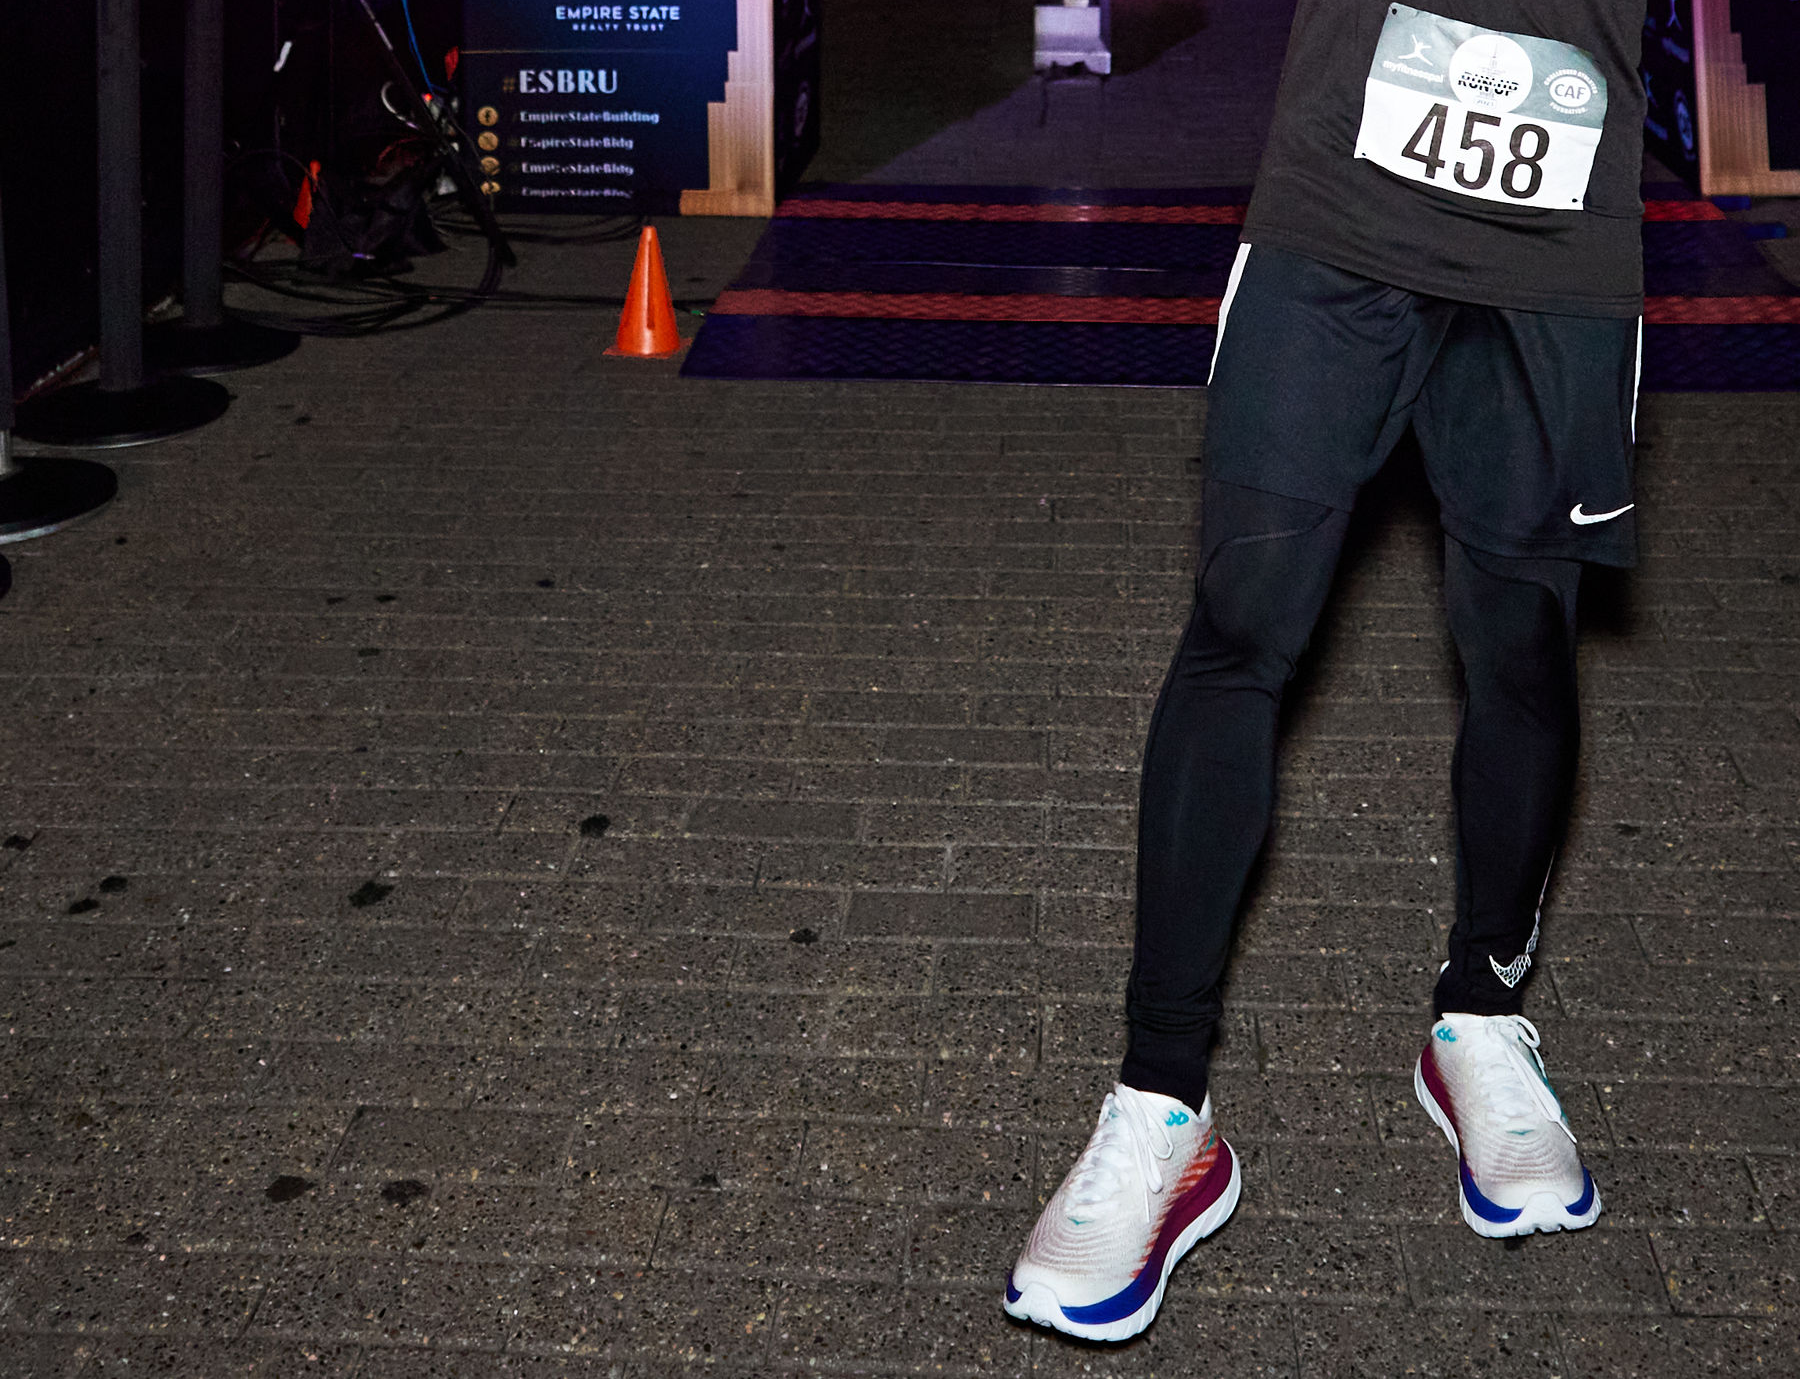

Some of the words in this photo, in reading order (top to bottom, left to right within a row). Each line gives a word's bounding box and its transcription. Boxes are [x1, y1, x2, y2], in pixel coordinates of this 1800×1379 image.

[555, 5, 623, 20] EMPIRE
[628, 5, 680, 20] STATE
[503, 69, 618, 94] #ESBRU
[1554, 83, 1587, 100] CAF
[1401, 103, 1550, 199] 458
